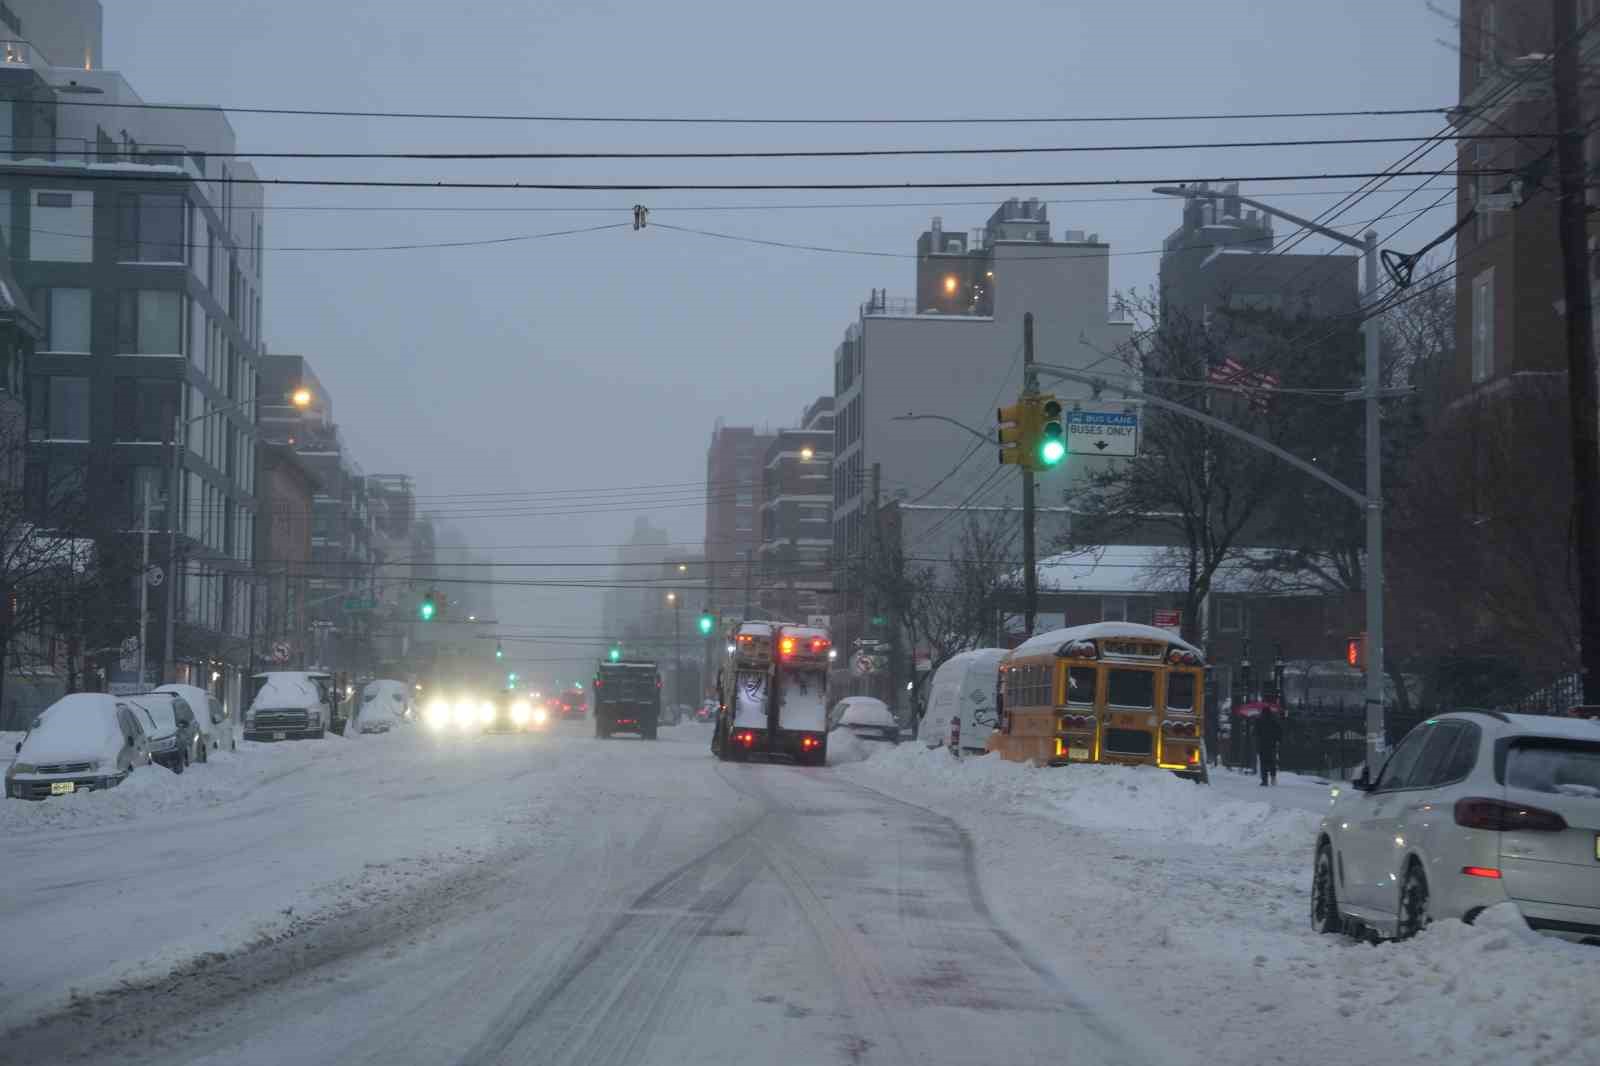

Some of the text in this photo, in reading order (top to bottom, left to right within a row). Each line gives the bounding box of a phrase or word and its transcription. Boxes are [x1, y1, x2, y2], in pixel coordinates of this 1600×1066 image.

[1087, 415, 1105, 423] BUS
[1070, 424, 1133, 437] BUSES ONLY
